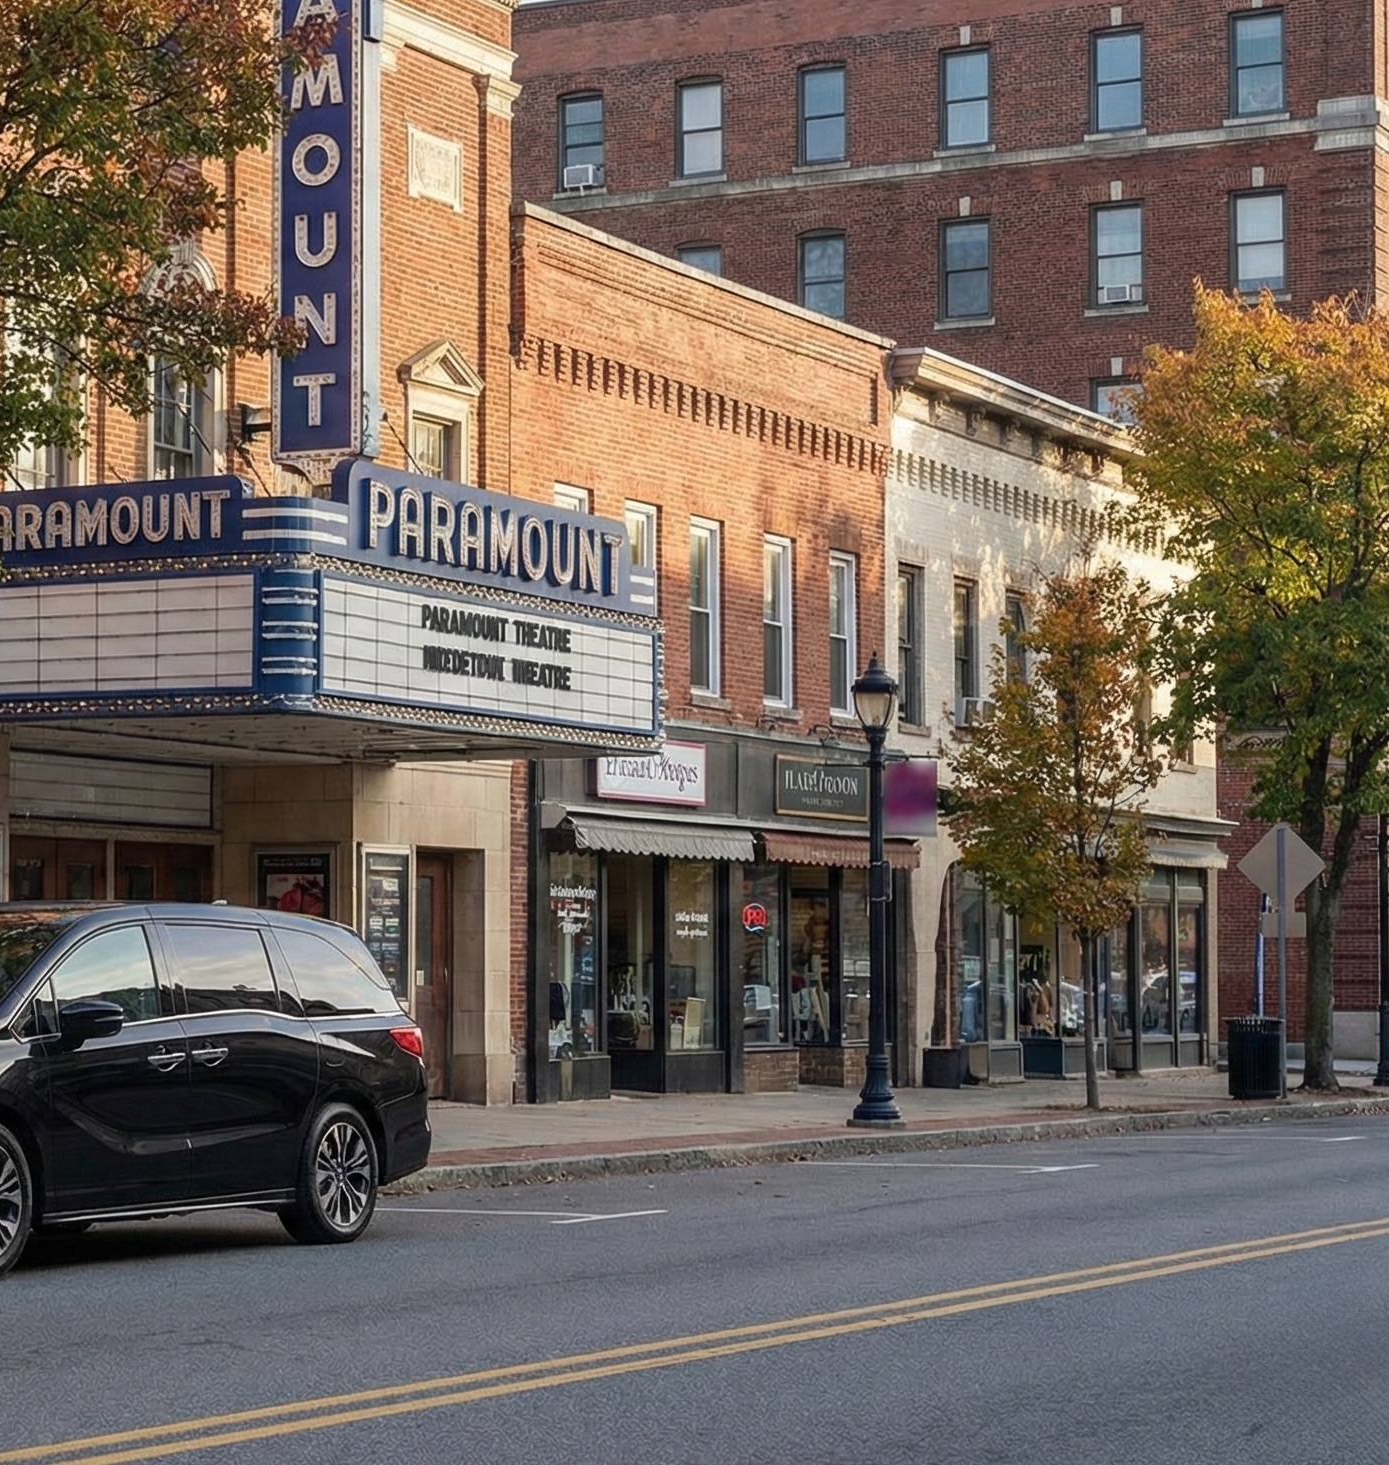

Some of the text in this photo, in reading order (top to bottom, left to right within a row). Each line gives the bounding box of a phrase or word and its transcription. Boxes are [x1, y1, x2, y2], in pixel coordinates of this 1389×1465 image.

[366, 479, 625, 596] PARAMOUNT
[421, 603, 572, 653] PARAMOUNT THEATRE
